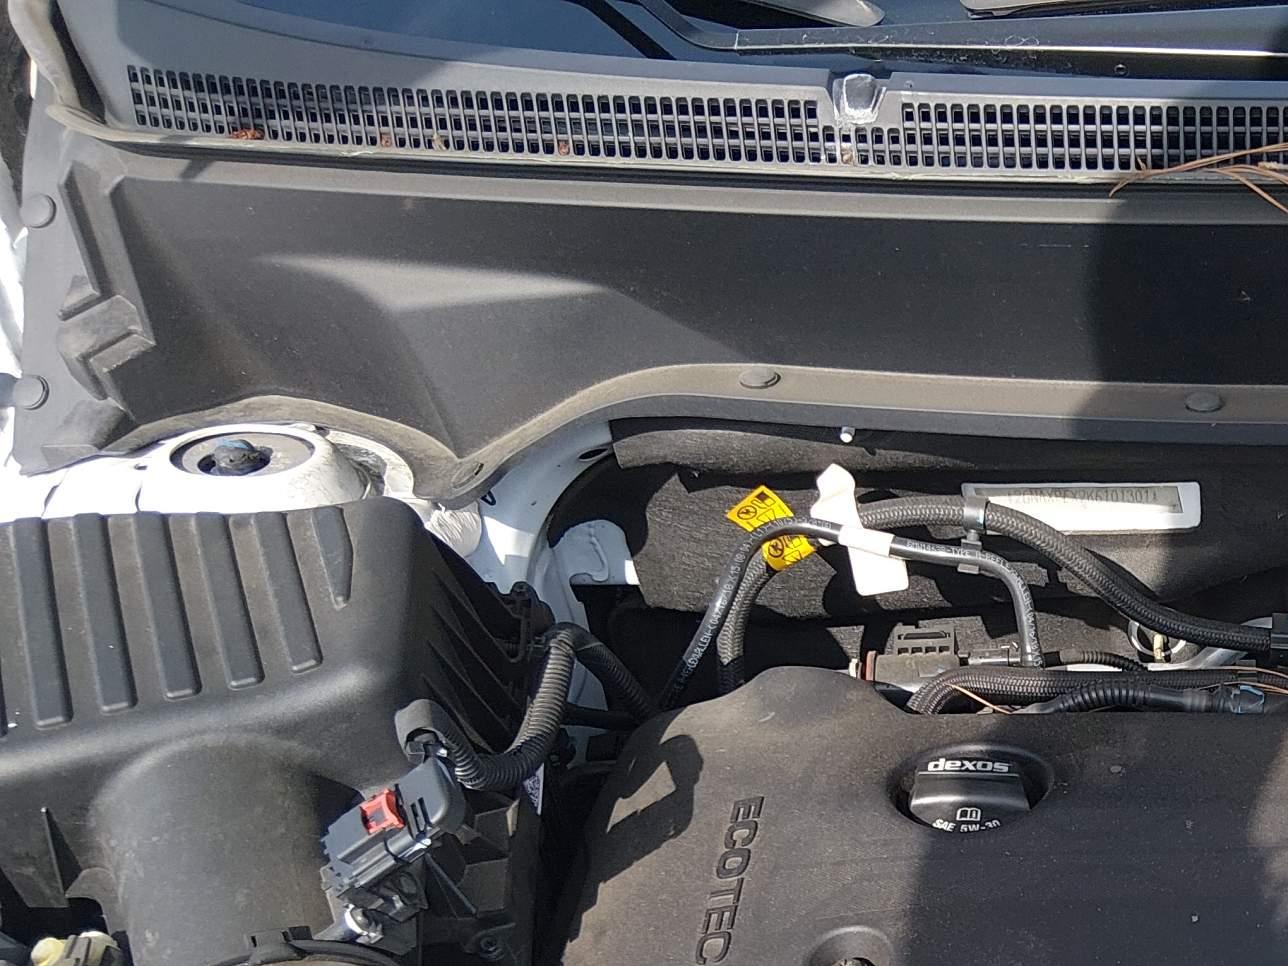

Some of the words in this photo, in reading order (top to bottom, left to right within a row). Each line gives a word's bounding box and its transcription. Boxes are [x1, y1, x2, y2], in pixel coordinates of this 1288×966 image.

[927, 757, 1009, 773] dexos
[932, 818, 957, 832] SAE
[695, 795, 765, 966] ECOTEC
